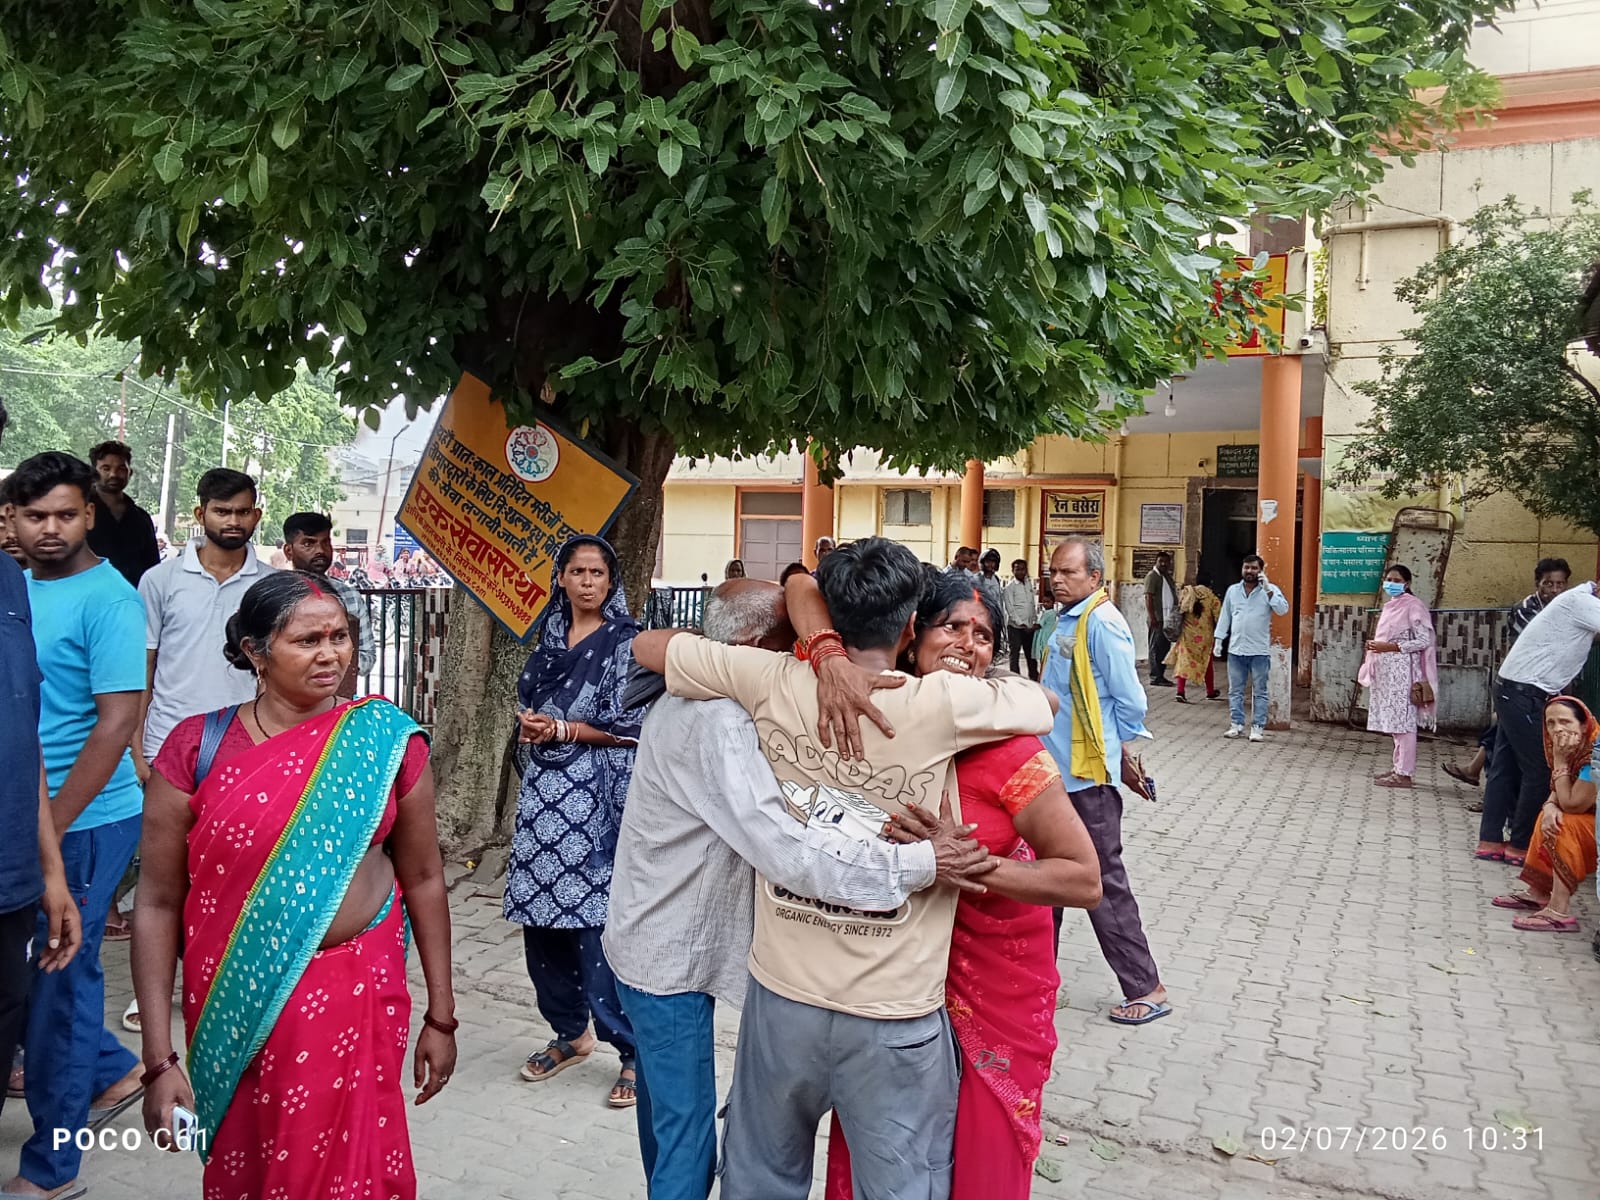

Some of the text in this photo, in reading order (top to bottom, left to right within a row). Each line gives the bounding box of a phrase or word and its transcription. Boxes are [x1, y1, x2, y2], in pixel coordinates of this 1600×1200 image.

[472, 479, 497, 507] लिए
[526, 524, 546, 546] दूध
[492, 470, 535, 508] प्रतिदिन
[1053, 495, 1100, 513] रेन बसेरा
[412, 479, 454, 531] एक
[446, 509, 493, 566] सेवा
[427, 466, 441, 486] की
[438, 477, 465, 507] सेवा
[496, 525, 529, 556] जाती
[522, 544, 538, 565] है
[775, 907, 811, 924] ORGANIC
[843, 925, 869, 937] SINCE
[871, 927, 893, 938] 1972
